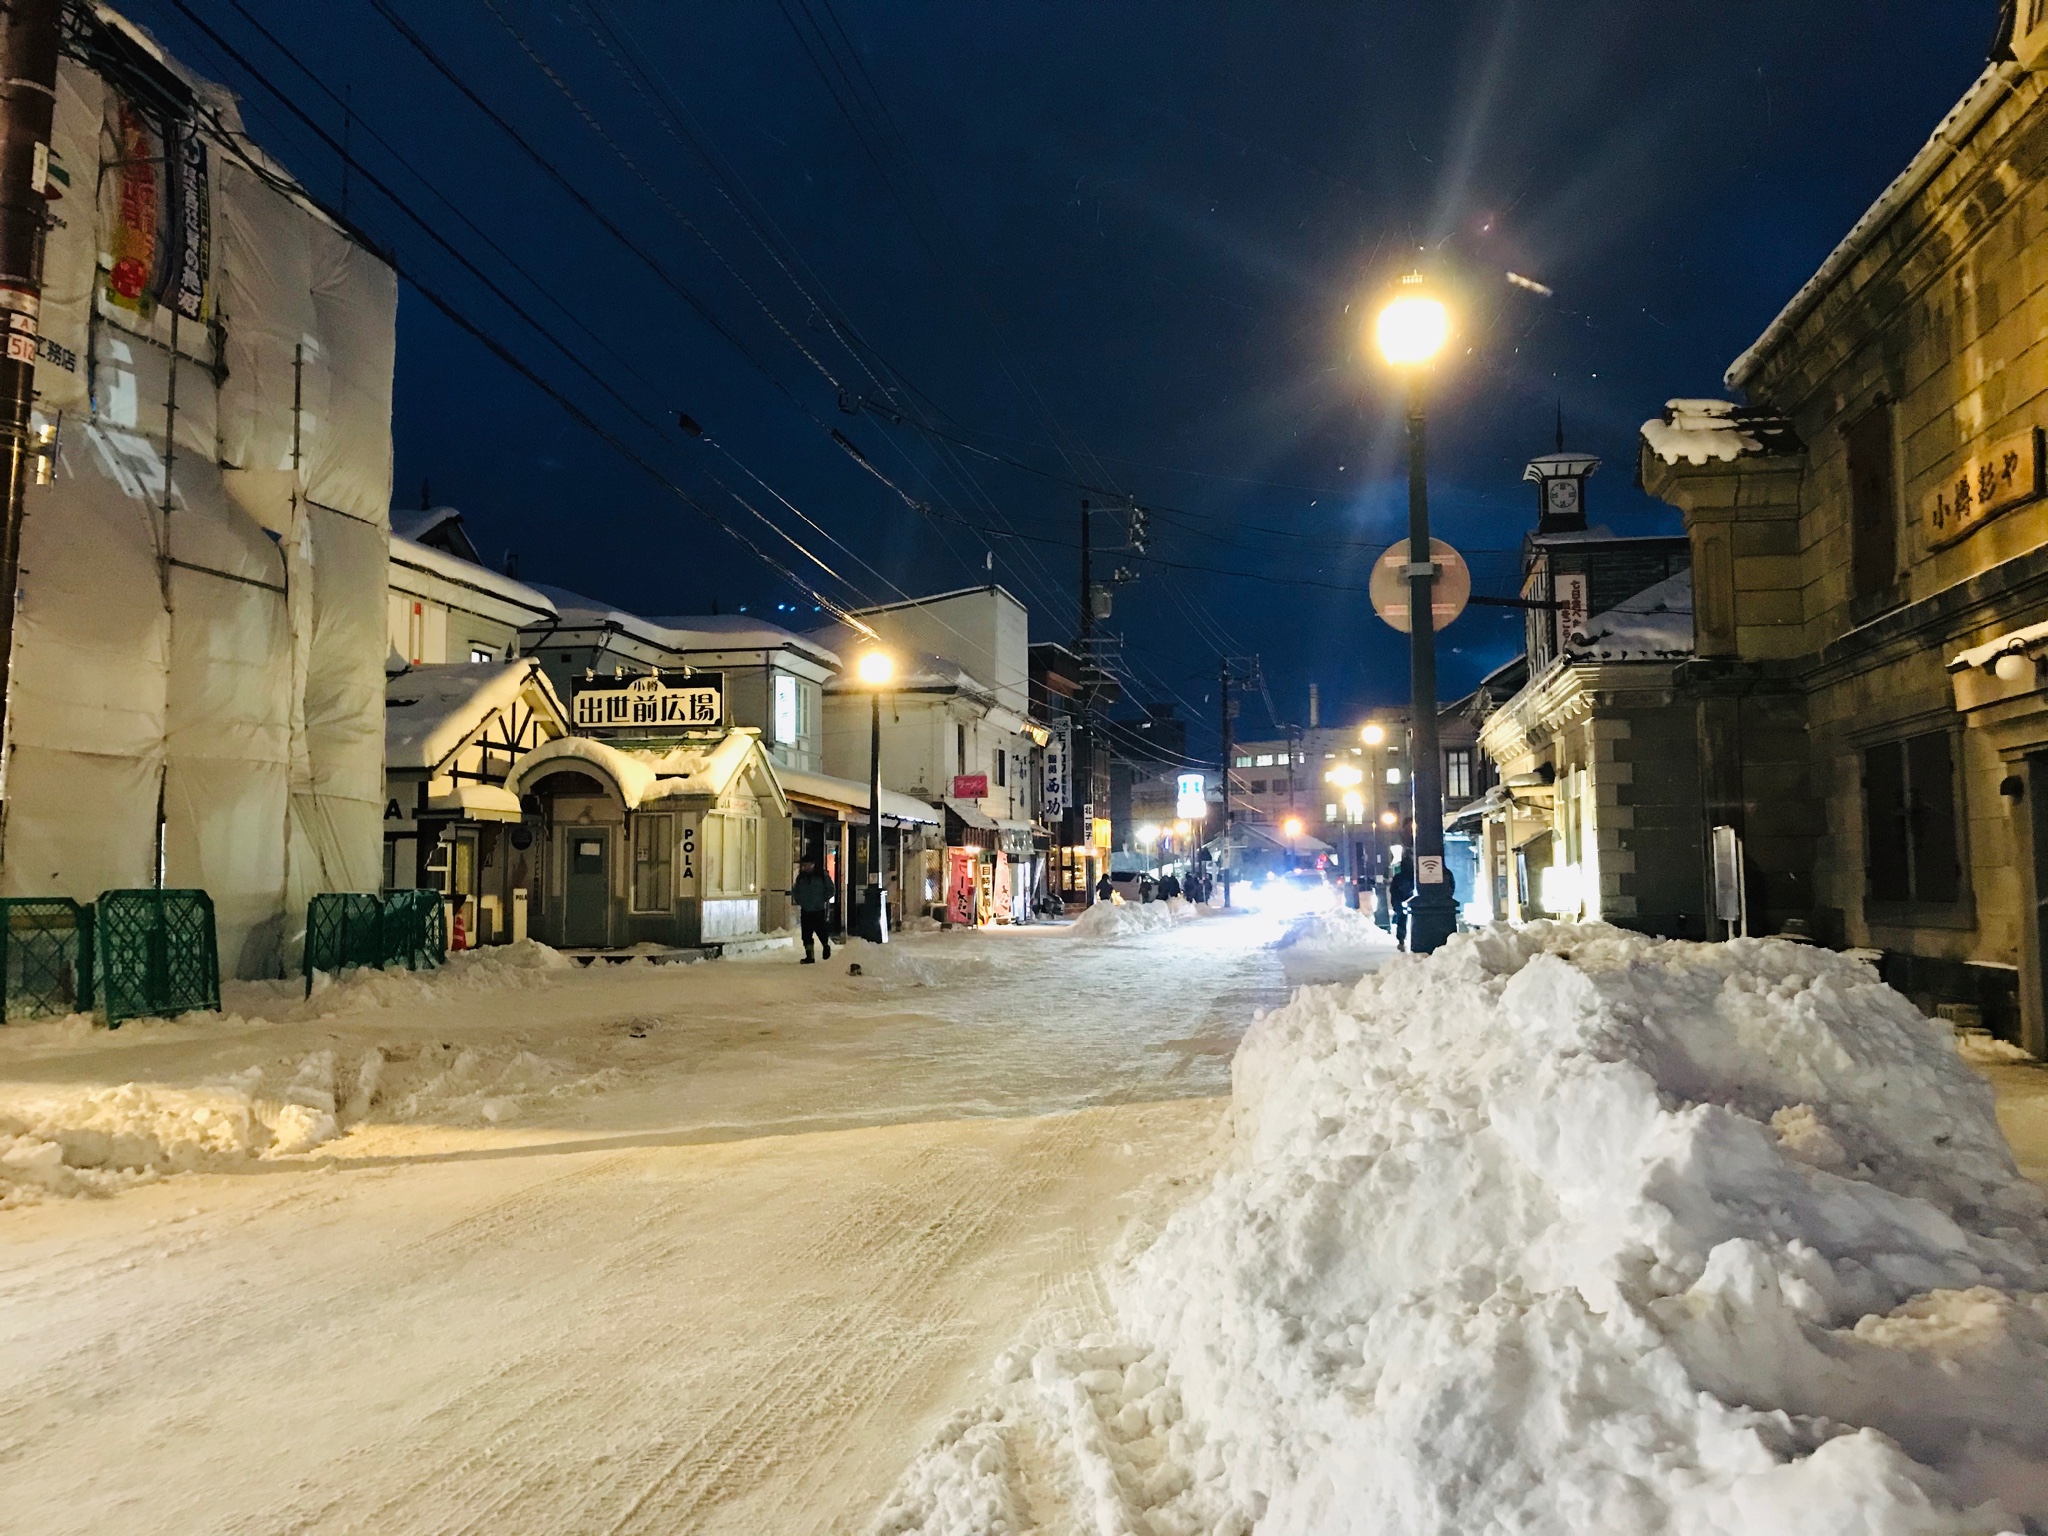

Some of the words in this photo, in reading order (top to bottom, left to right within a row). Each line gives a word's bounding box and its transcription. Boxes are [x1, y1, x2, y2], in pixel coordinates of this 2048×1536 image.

[579, 693, 714, 724] 出世前広場
[958, 781, 986, 789] ラーメン
[683, 829, 695, 878] POLA
